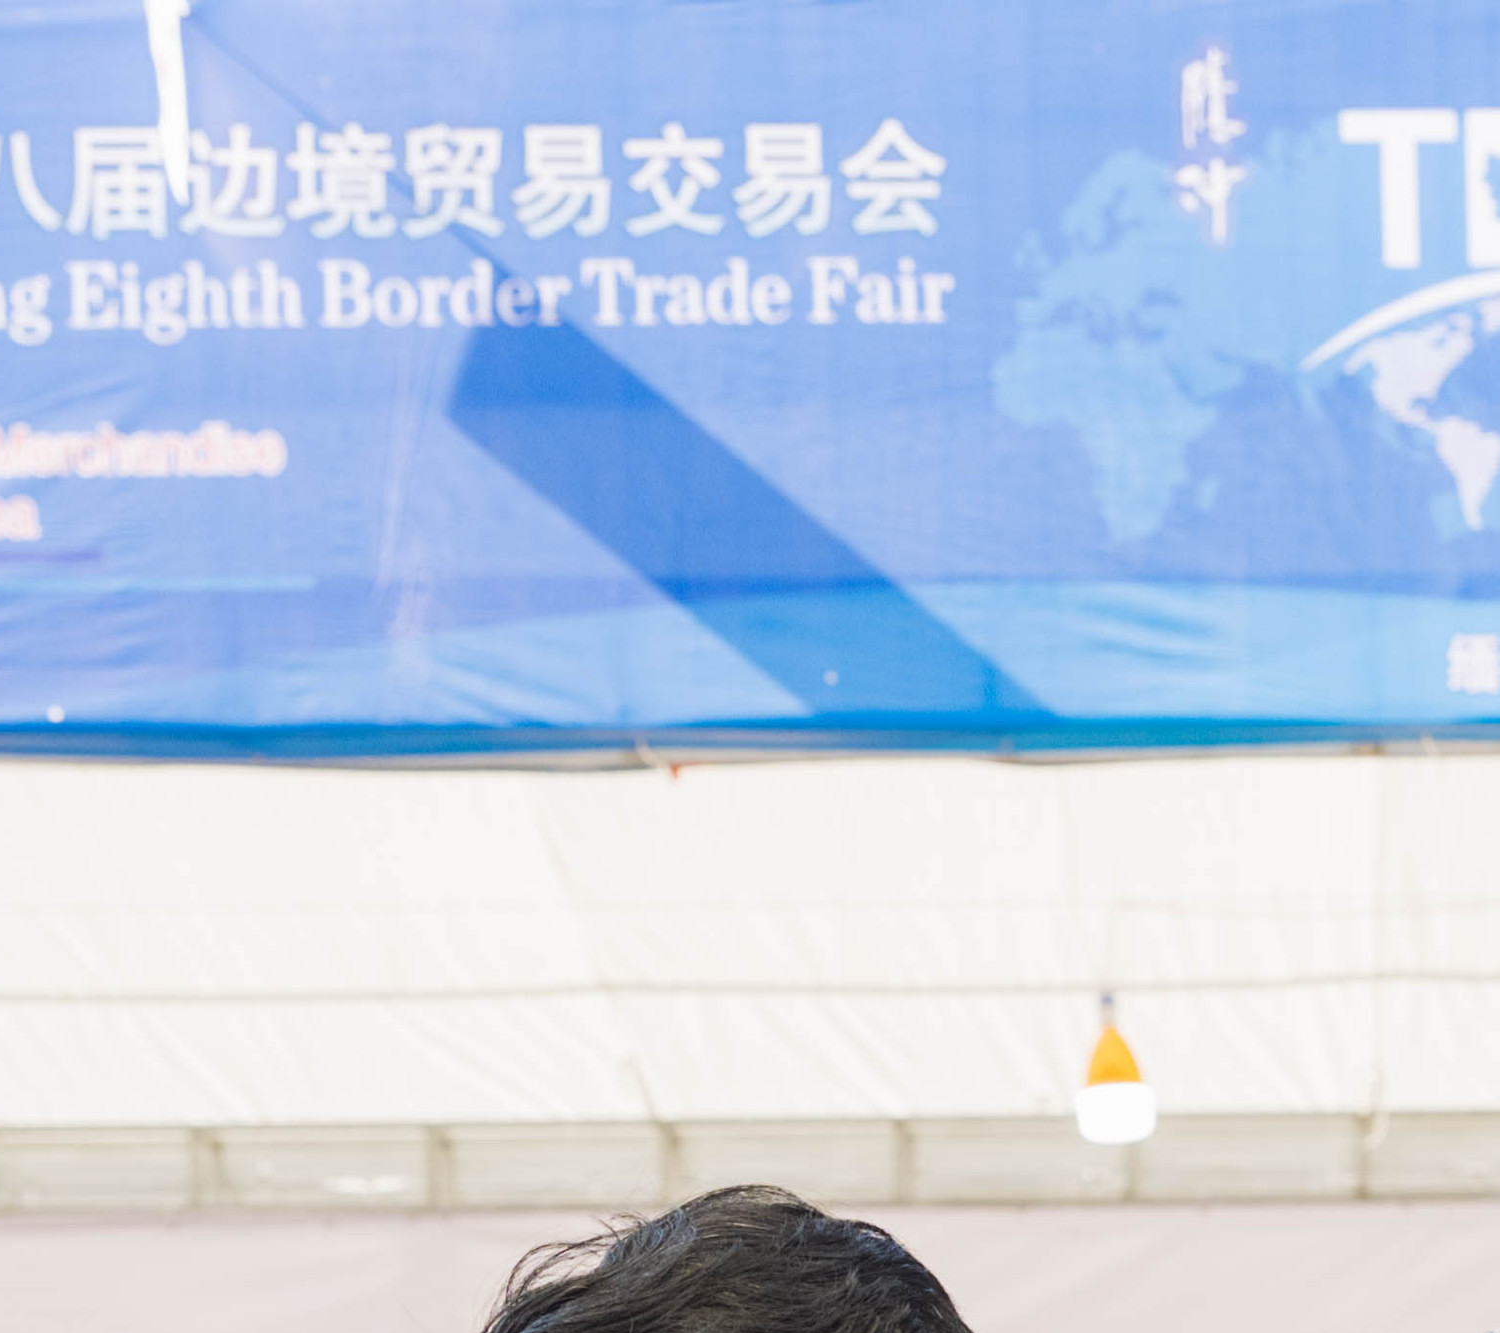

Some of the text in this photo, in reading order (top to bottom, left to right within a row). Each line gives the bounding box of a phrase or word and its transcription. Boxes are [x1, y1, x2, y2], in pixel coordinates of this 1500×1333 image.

[66, 256, 306, 346] Eighth
[318, 256, 571, 329] Border
[581, 254, 792, 328] Trade
[808, 252, 957, 326] Fair
